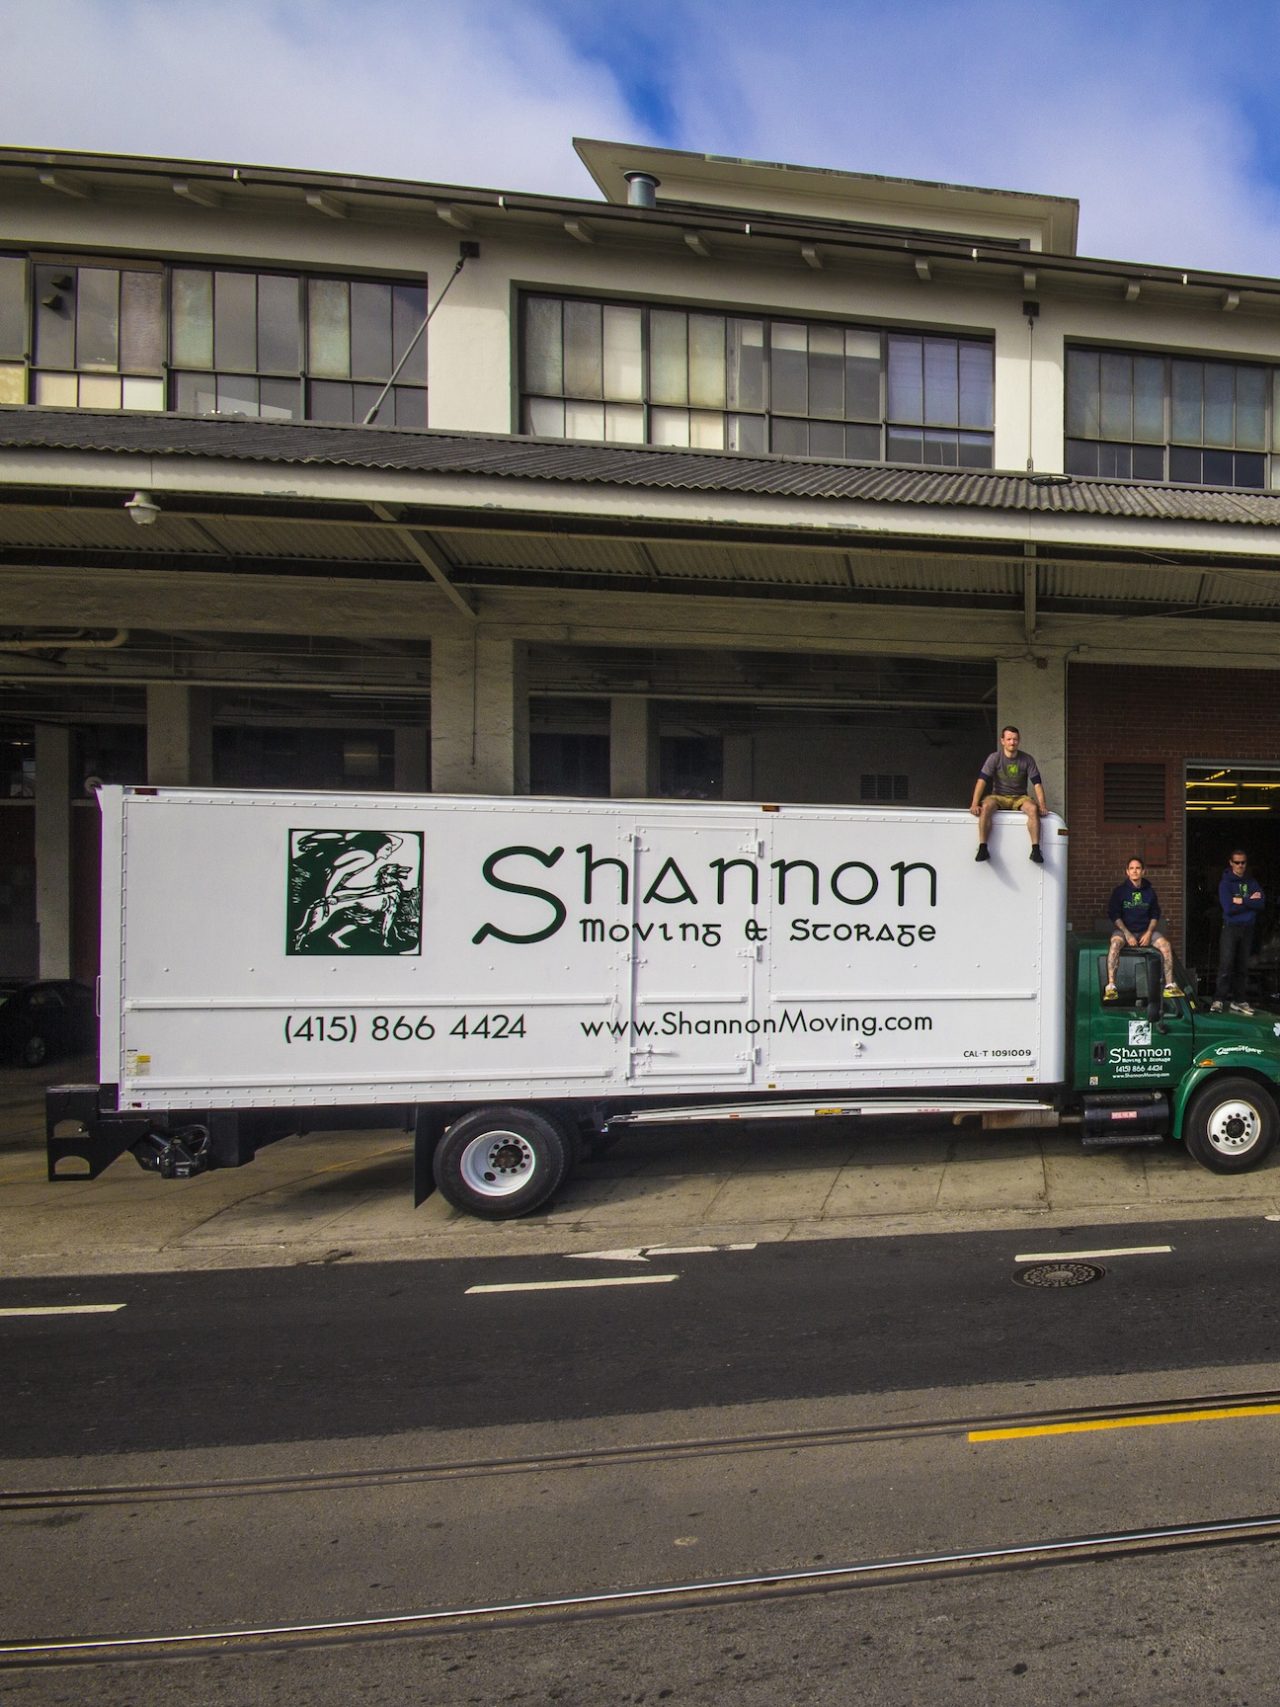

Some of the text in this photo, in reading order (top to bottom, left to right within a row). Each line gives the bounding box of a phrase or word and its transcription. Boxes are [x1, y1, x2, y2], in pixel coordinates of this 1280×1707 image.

[471, 843, 938, 946] Shannon
[579, 918, 937, 948] Moving & Storage
[284, 1014, 527, 1043] (415) 866 4424
[580, 1009, 934, 1037] www.ShannonMoving.com
[963, 1049, 1032, 1058] CAL-T 1091009
[1109, 1047, 1171, 1064] Shannon
